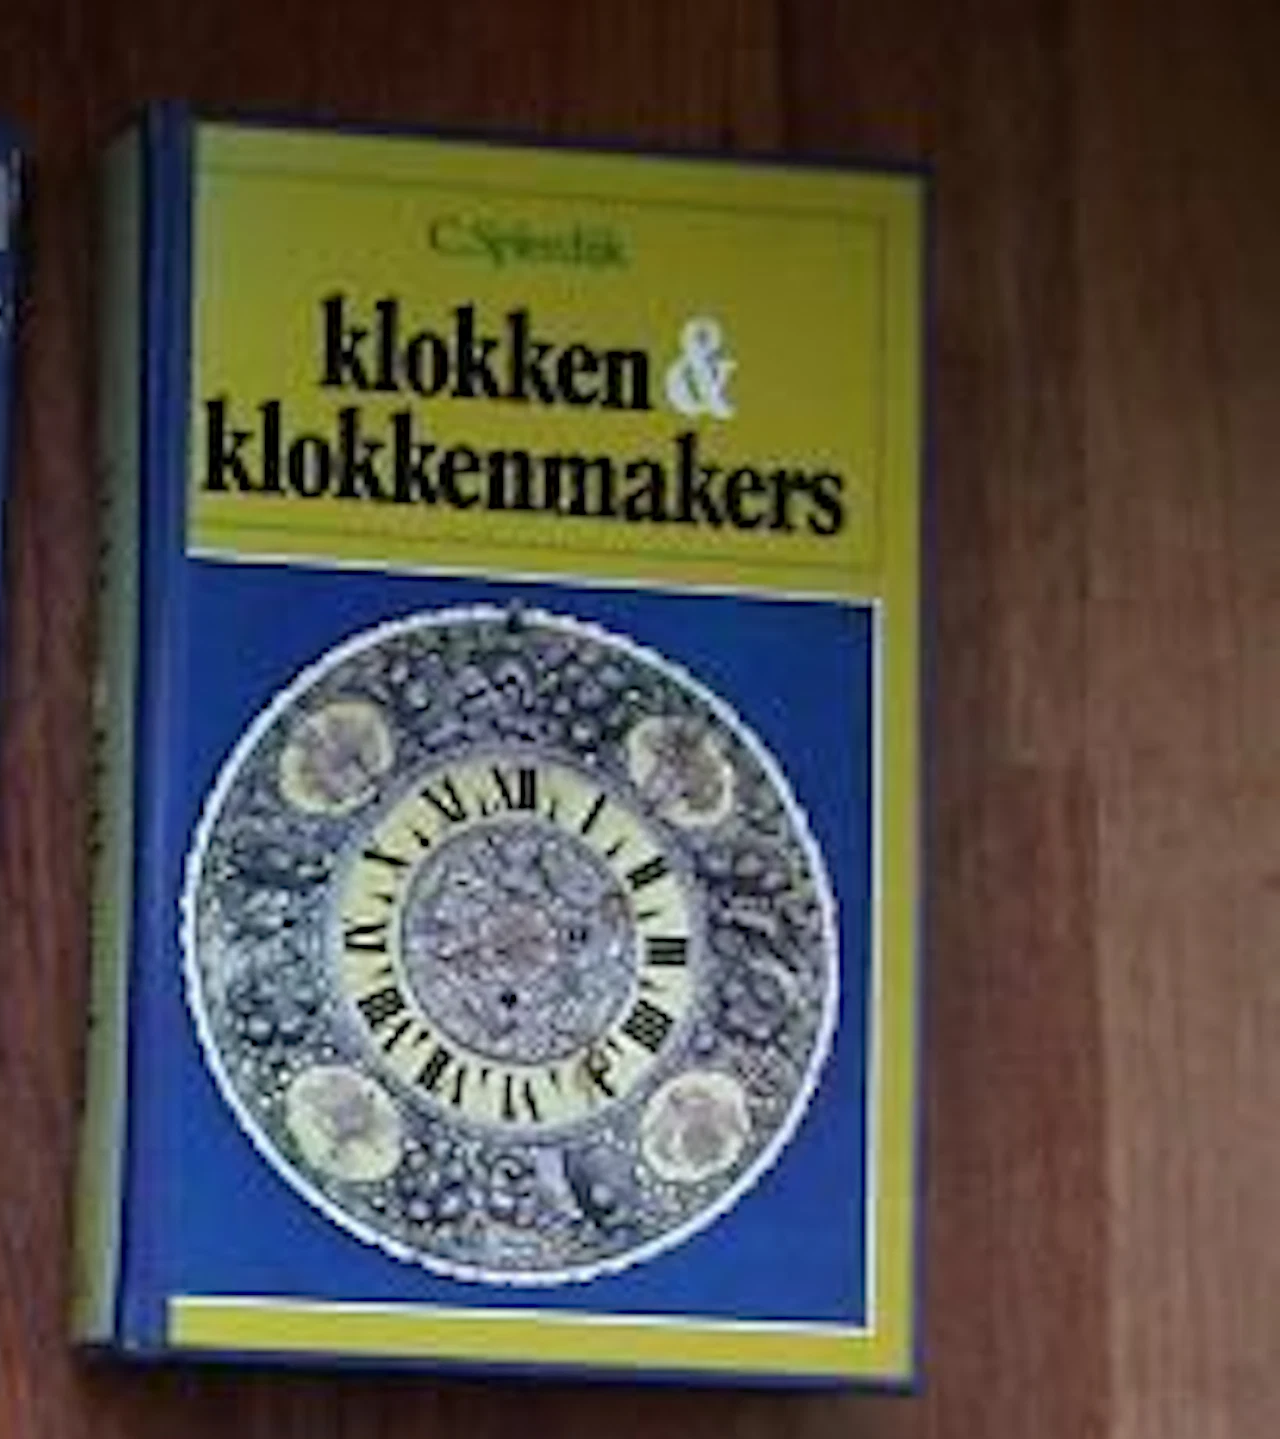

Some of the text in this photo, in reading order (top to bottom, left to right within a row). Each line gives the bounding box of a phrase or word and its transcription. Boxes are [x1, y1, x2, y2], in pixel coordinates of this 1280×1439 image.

[318, 294, 737, 420] klokken &
[202, 394, 846, 536] klokkenmakers
